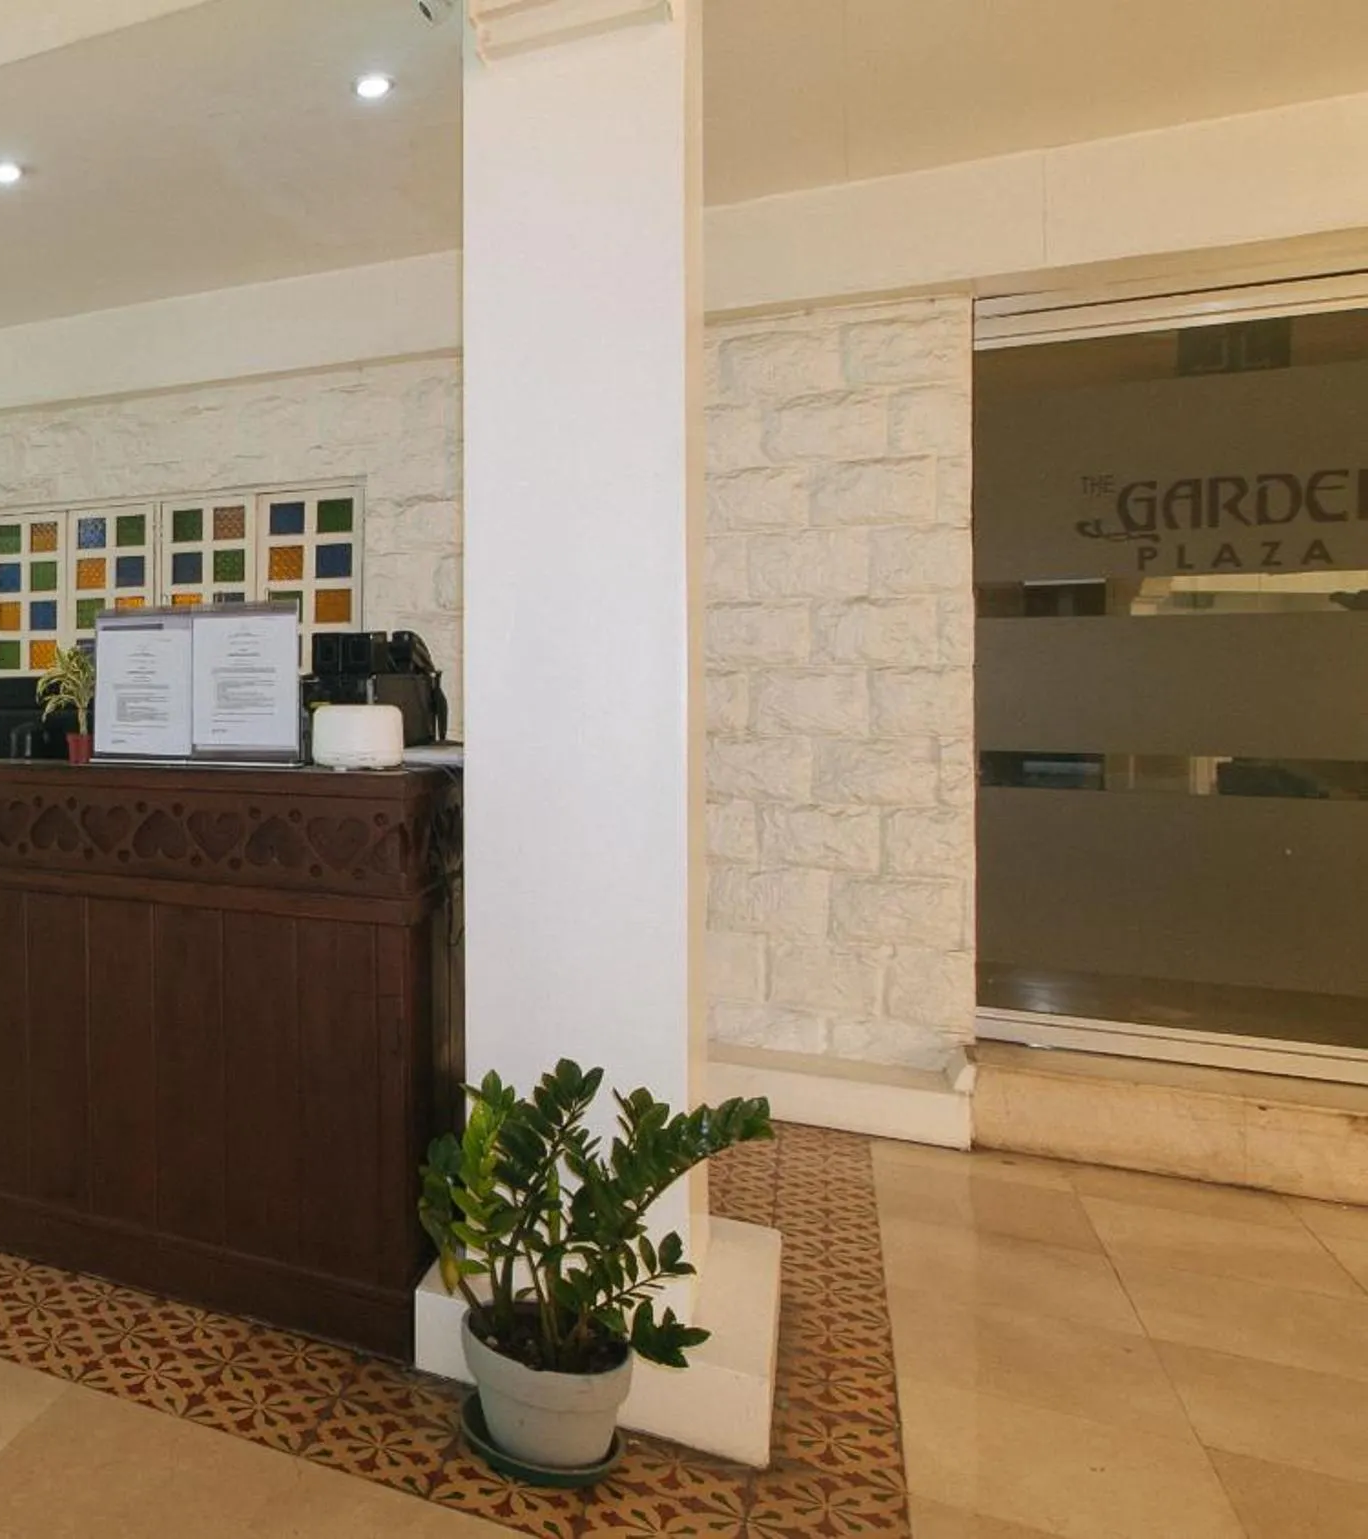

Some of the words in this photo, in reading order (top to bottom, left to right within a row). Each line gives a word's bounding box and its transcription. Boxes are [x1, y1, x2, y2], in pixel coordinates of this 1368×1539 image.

[1080, 474, 1116, 496] THE
[1116, 467, 1368, 532] GARDE
[1137, 538, 1334, 571] PLAZA
